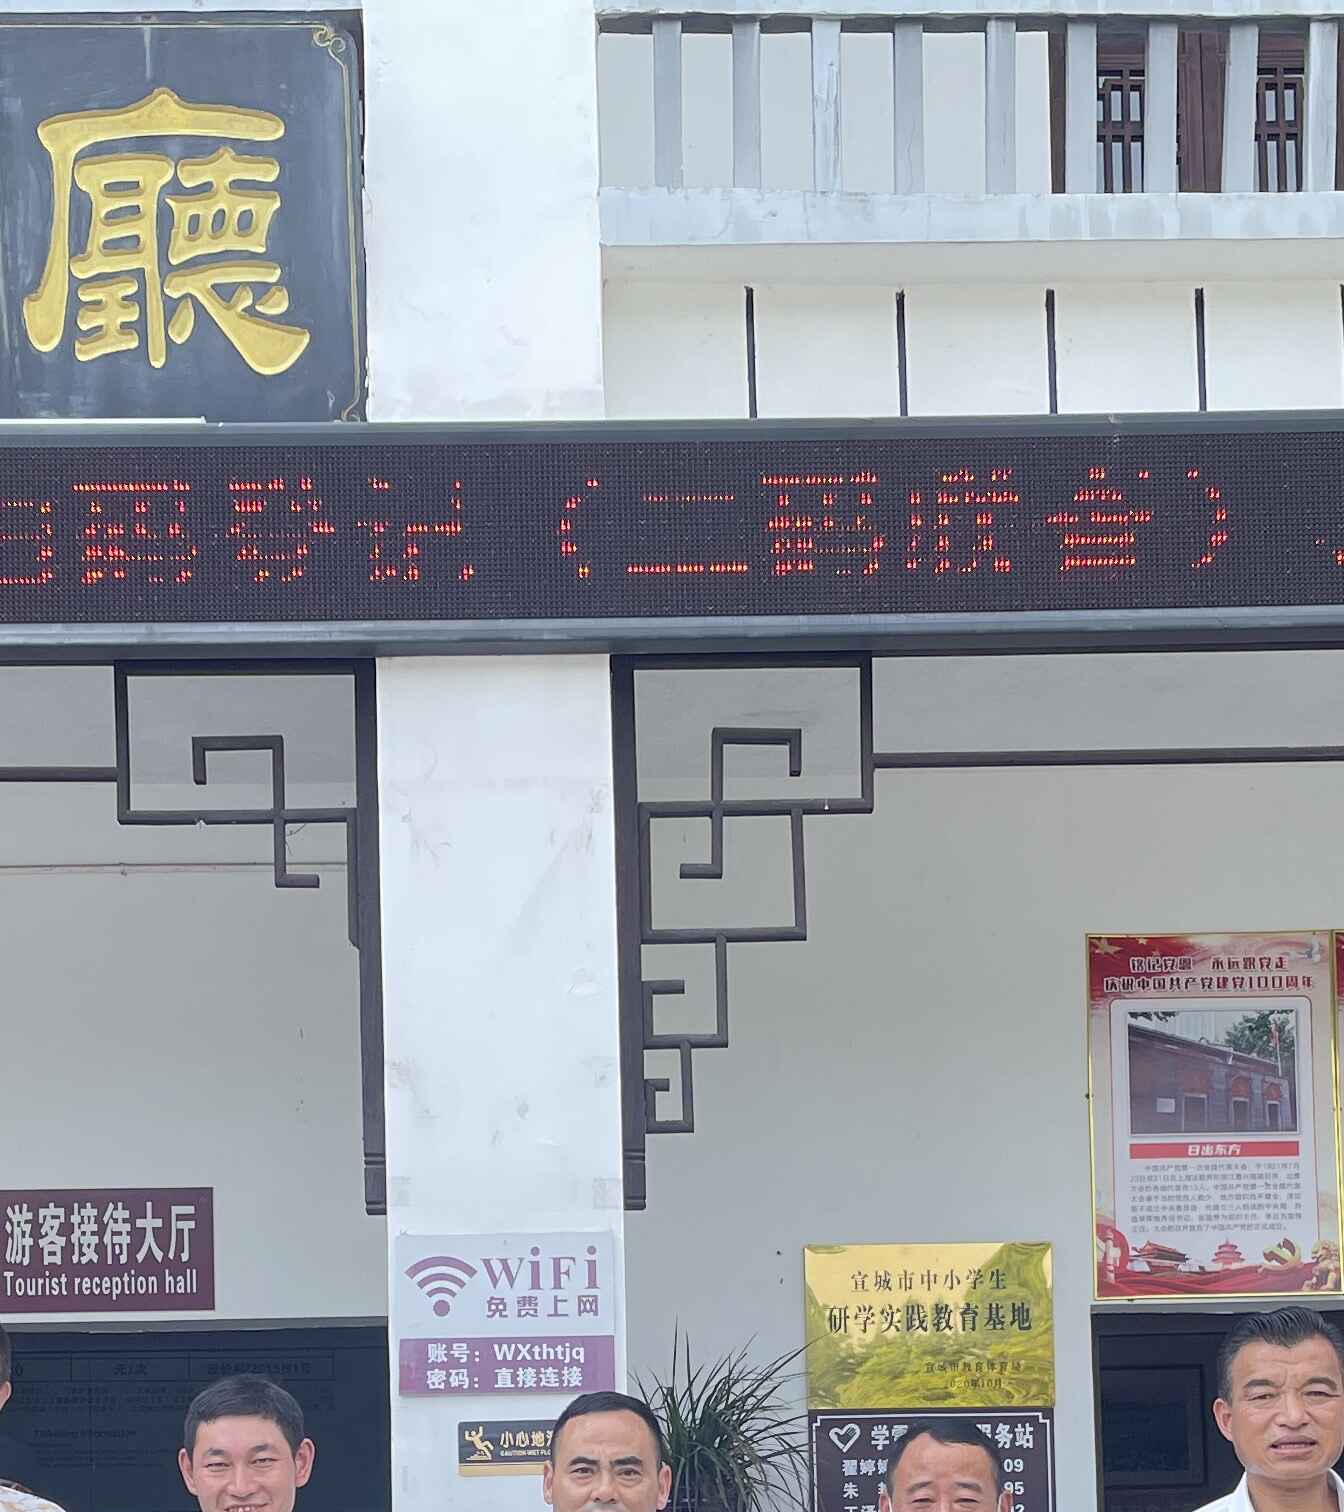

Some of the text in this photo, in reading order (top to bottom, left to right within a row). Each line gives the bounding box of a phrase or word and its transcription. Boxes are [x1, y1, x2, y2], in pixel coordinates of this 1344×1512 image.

[1187, 1143, 1242, 1157] 日出东方
[4, 1201, 196, 1267] 游客接待大厅
[3, 1268, 198, 1299] Tourist reception hall
[481, 1246, 600, 1293] WiFi
[850, 1268, 1007, 1293] 宣城市中小学生
[486, 1294, 601, 1319] 免费上网
[827, 1302, 1033, 1335] 研学实践教育基地
[1003, 1459, 1024, 1473] 09
